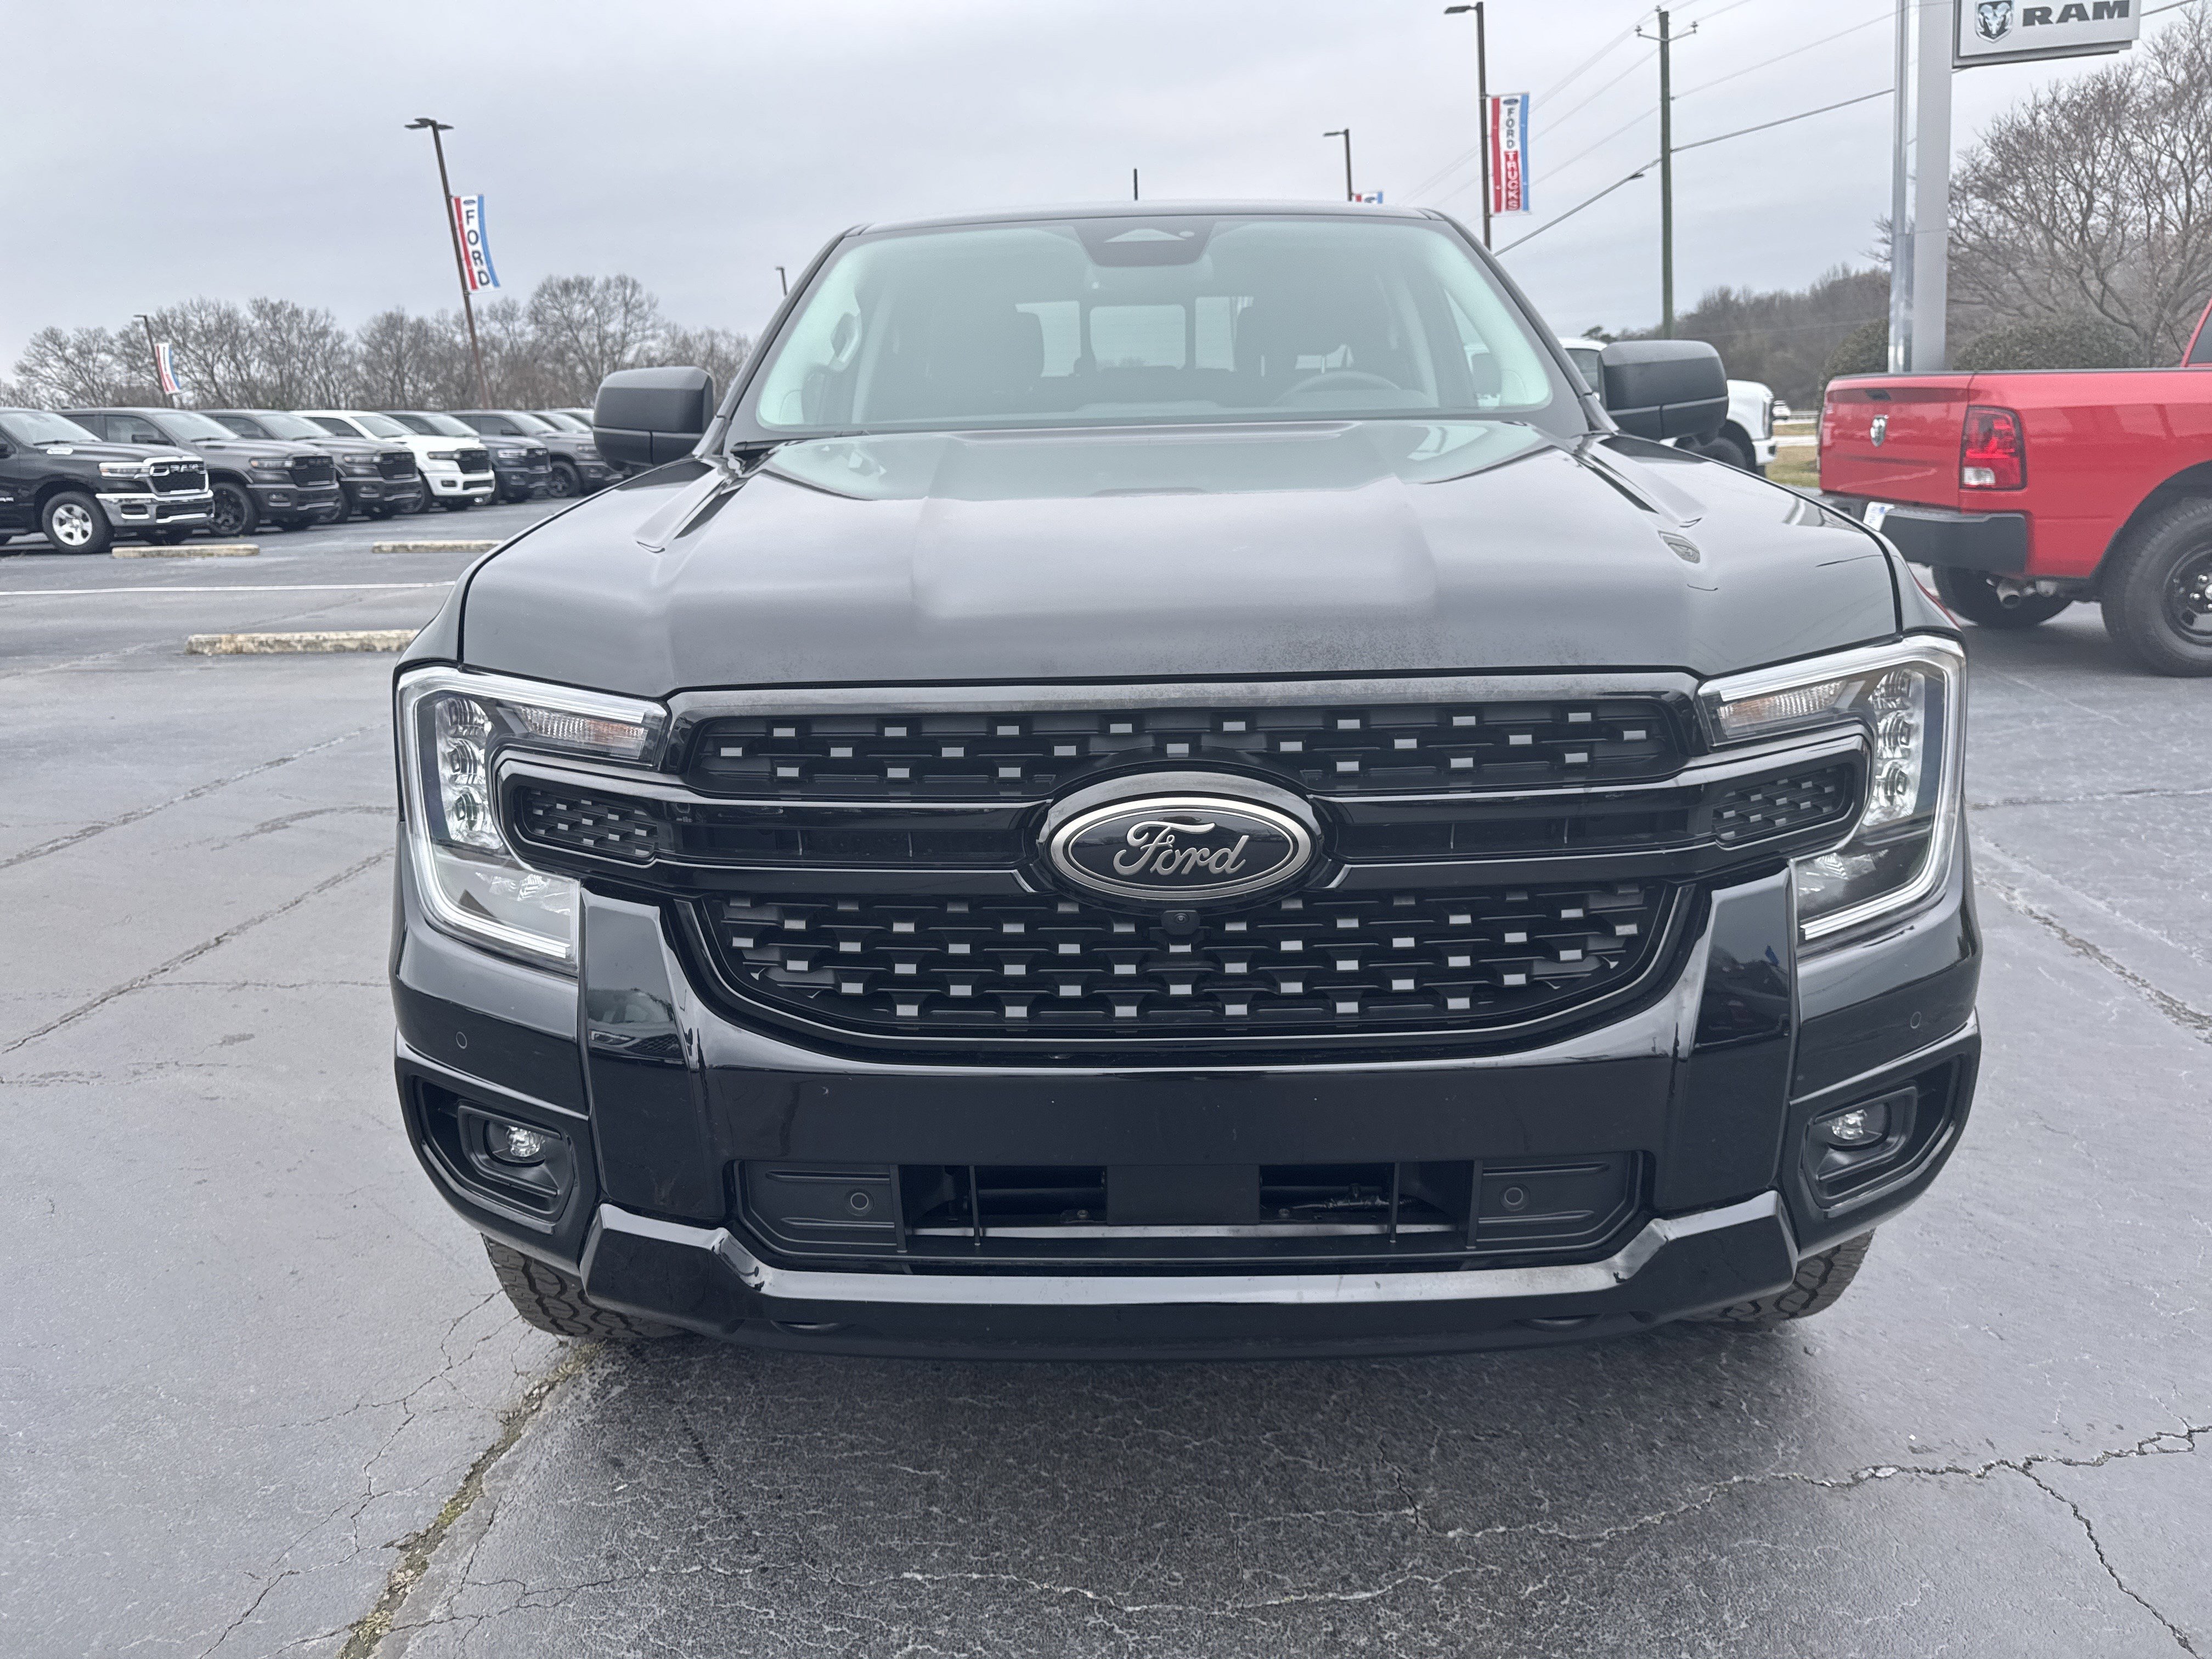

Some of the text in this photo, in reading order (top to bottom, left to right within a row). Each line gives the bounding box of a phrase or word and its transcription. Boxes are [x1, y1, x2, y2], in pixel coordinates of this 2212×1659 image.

[2022, 0, 2130, 27] RAM
[1505, 107, 1515, 149] FORD
[1505, 151, 1519, 211] TRUCKS
[465, 209, 490, 286] FORD
[1113, 820, 1250, 876] Ford
